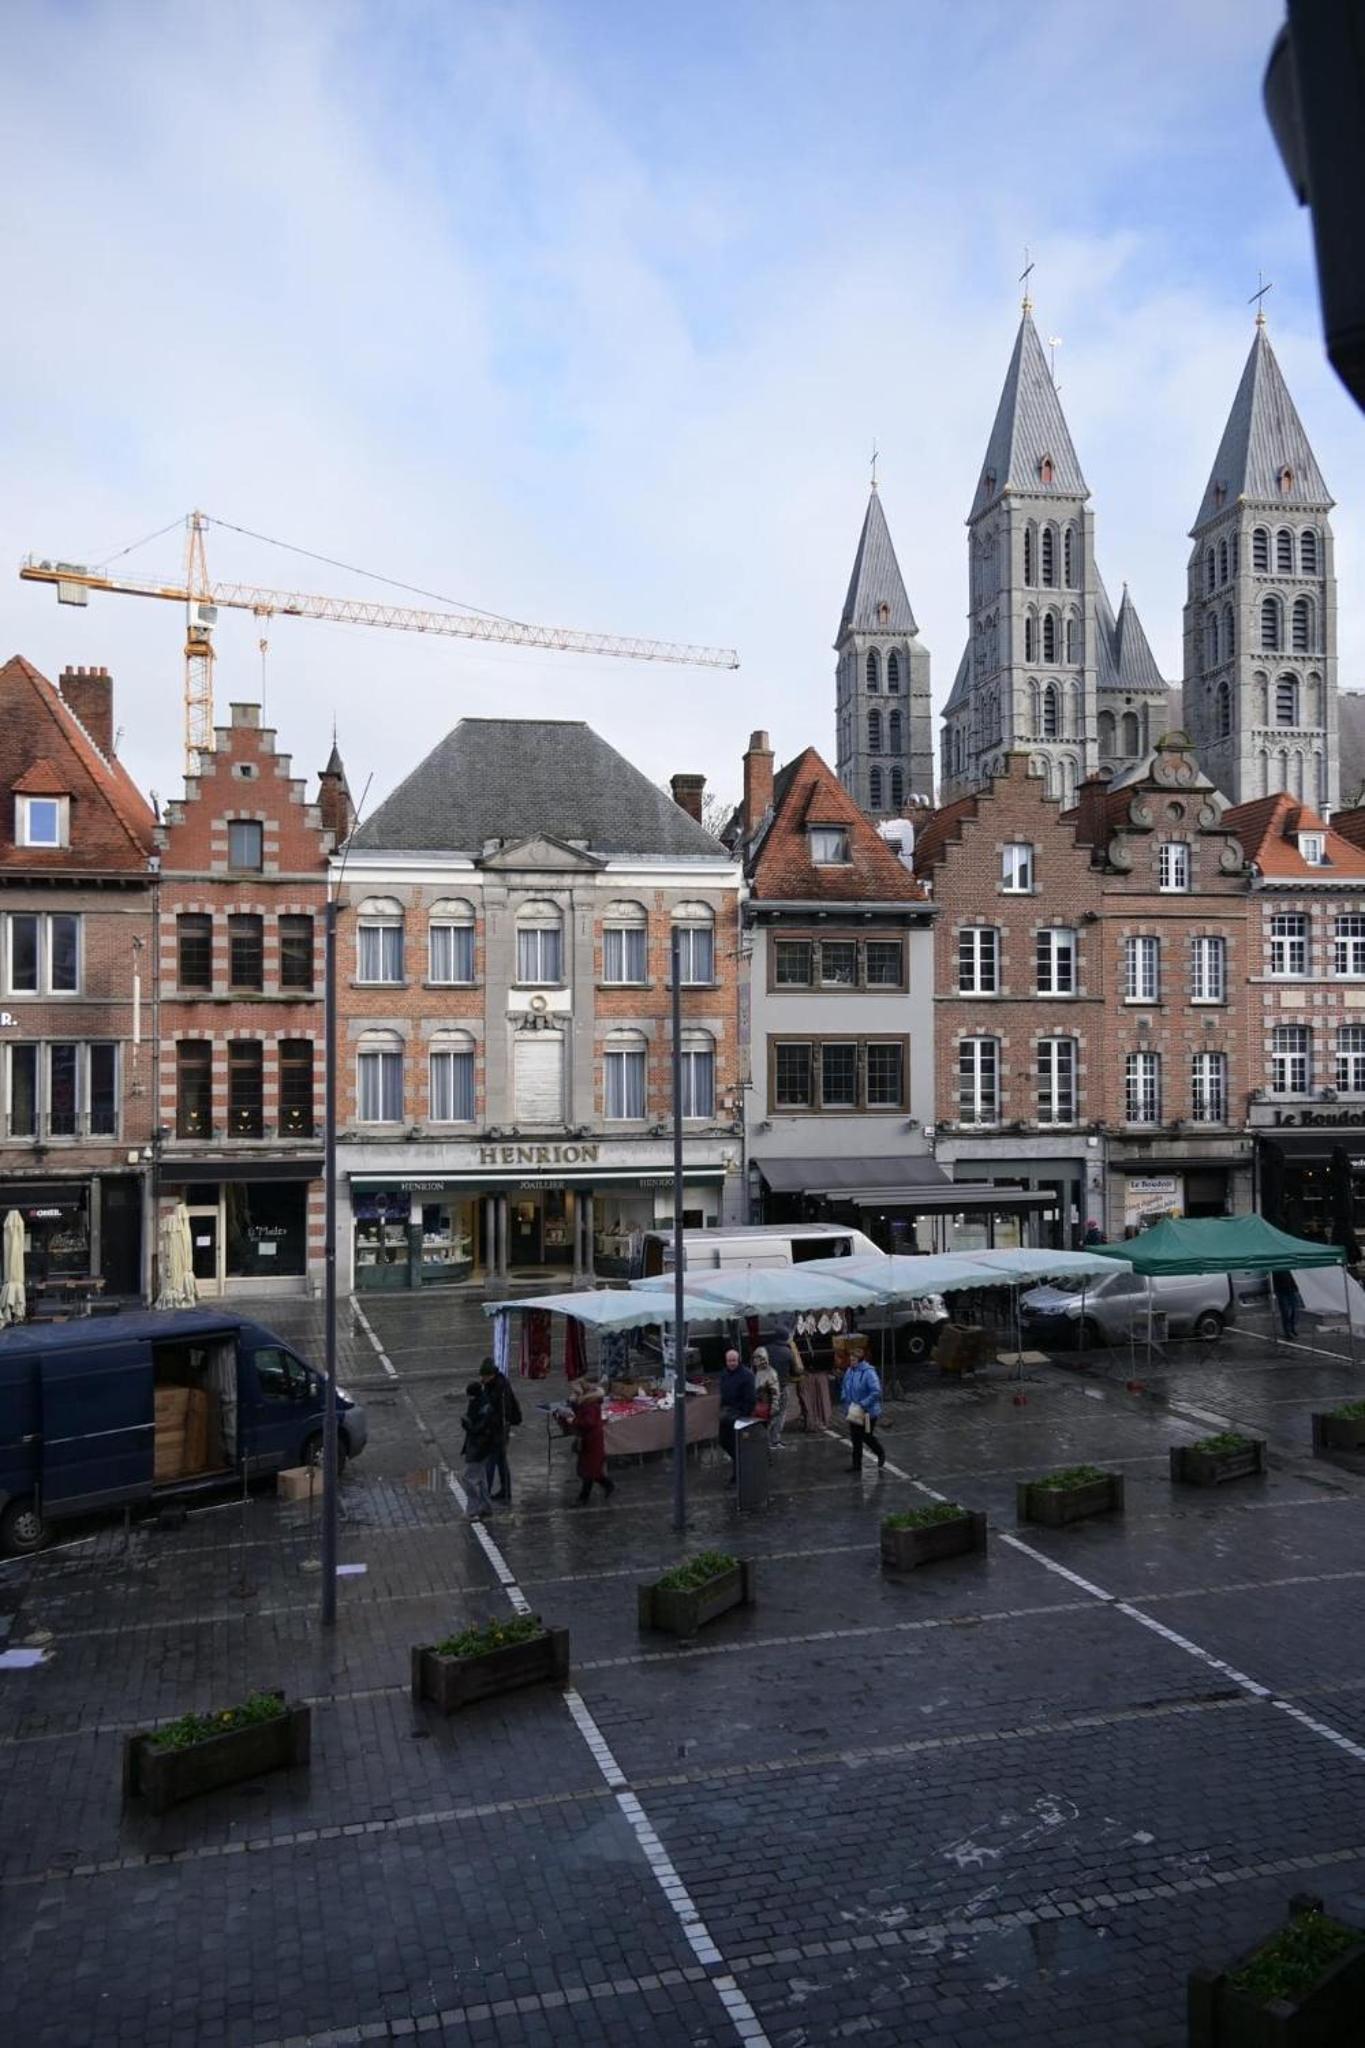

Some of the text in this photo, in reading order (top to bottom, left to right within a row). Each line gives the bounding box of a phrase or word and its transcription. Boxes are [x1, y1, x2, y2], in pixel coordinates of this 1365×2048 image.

[1274, 1110, 1296, 1127] Le
[479, 1145, 599, 1164] HENRION
[401, 1181, 445, 1191] HENRION
